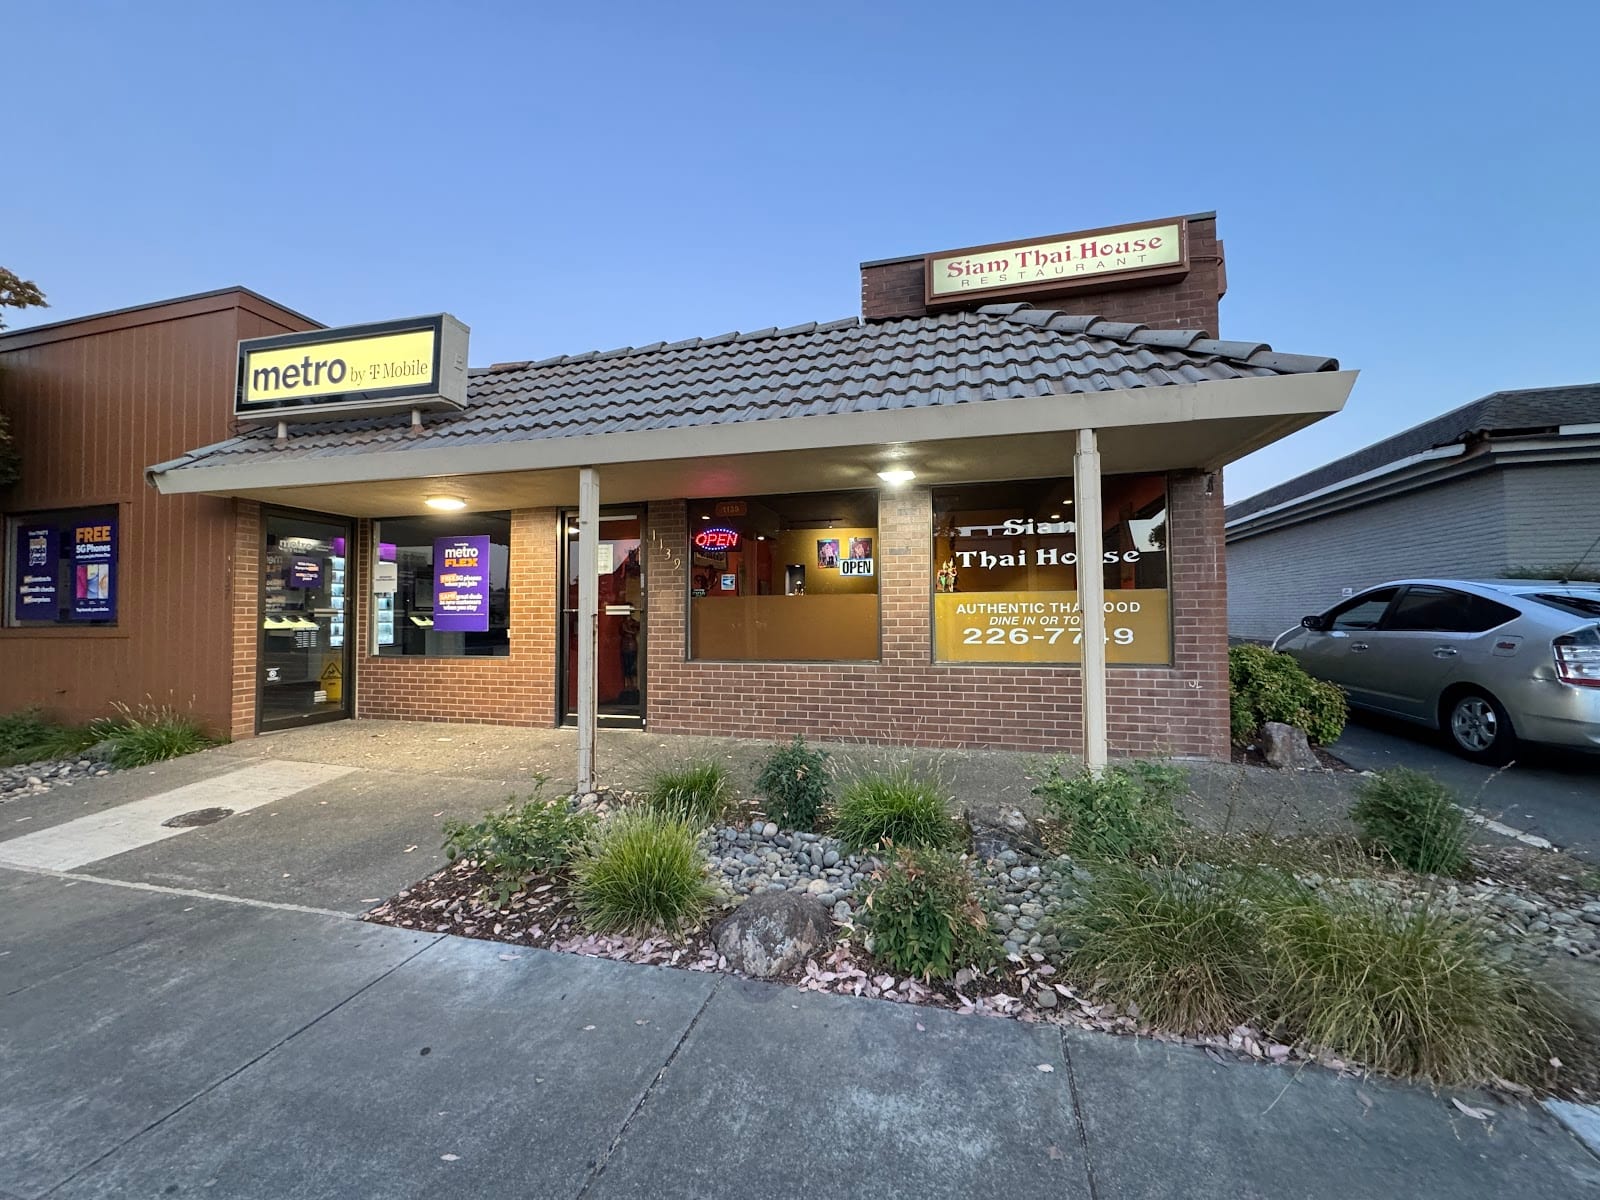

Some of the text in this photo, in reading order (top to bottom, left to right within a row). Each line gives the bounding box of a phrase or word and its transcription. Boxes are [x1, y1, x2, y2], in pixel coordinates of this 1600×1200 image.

[947, 237, 1163, 278] Siam Thai House
[961, 254, 1148, 287] RESTAURANT
[253, 356, 347, 391] metro
[350, 366, 366, 385] by
[76, 526, 111, 543] FREE
[695, 533, 738, 546] OPEN
[445, 546, 478, 558] metro
[955, 548, 1140, 570] Thai Hose
[444, 558, 478, 568] FLEX
[842, 560, 871, 574] OPEN
[956, 602, 1141, 614] AUTHENTIC THA OOD
[989, 616, 1080, 626] DINE IN OR TO
[963, 627, 1135, 645] 226-779
